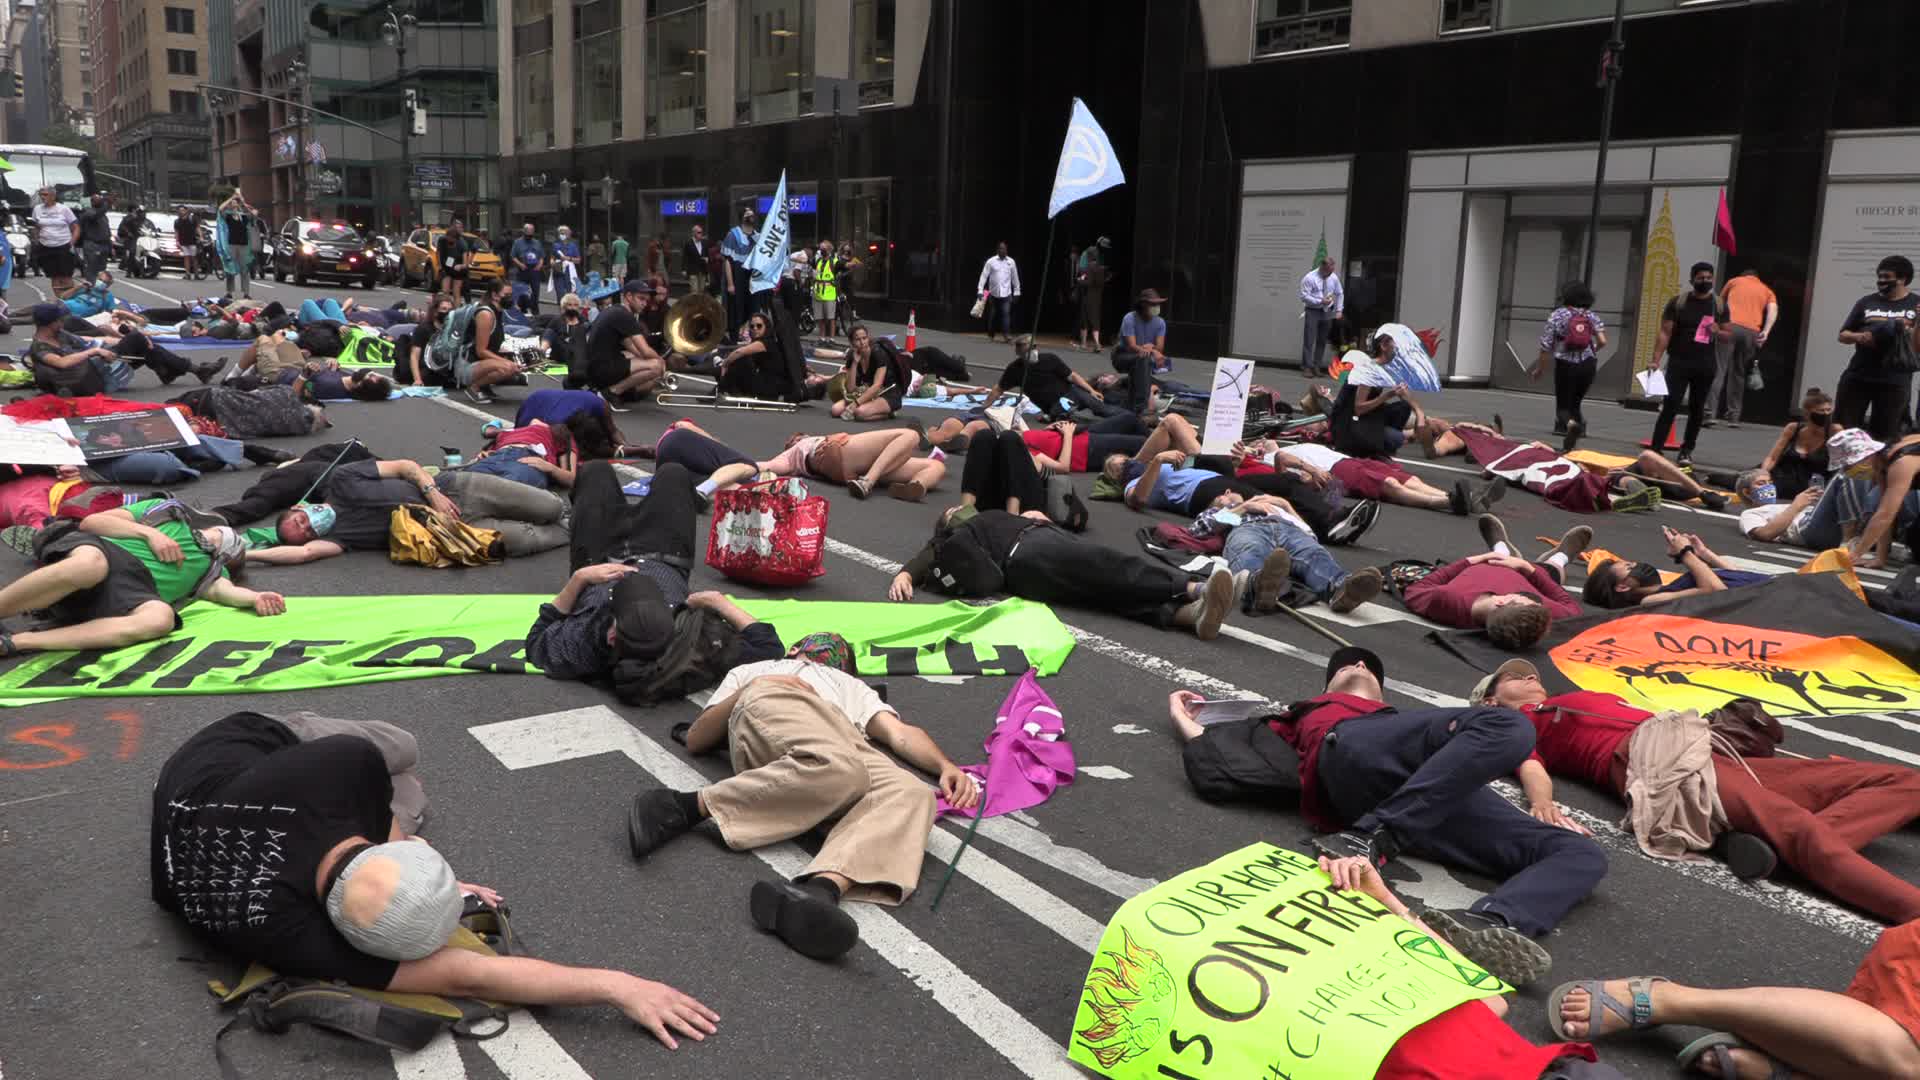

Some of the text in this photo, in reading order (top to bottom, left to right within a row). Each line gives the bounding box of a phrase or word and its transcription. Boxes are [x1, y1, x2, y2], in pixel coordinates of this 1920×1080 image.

[759, 224, 786, 258] SAVE
[1654, 630, 1783, 662] DOME
[1145, 849, 1320, 936] OUR HOME
[1187, 924, 1311, 1022] ON
[1265, 882, 1392, 948] FIRE
[1347, 974, 1438, 1029] NOW
